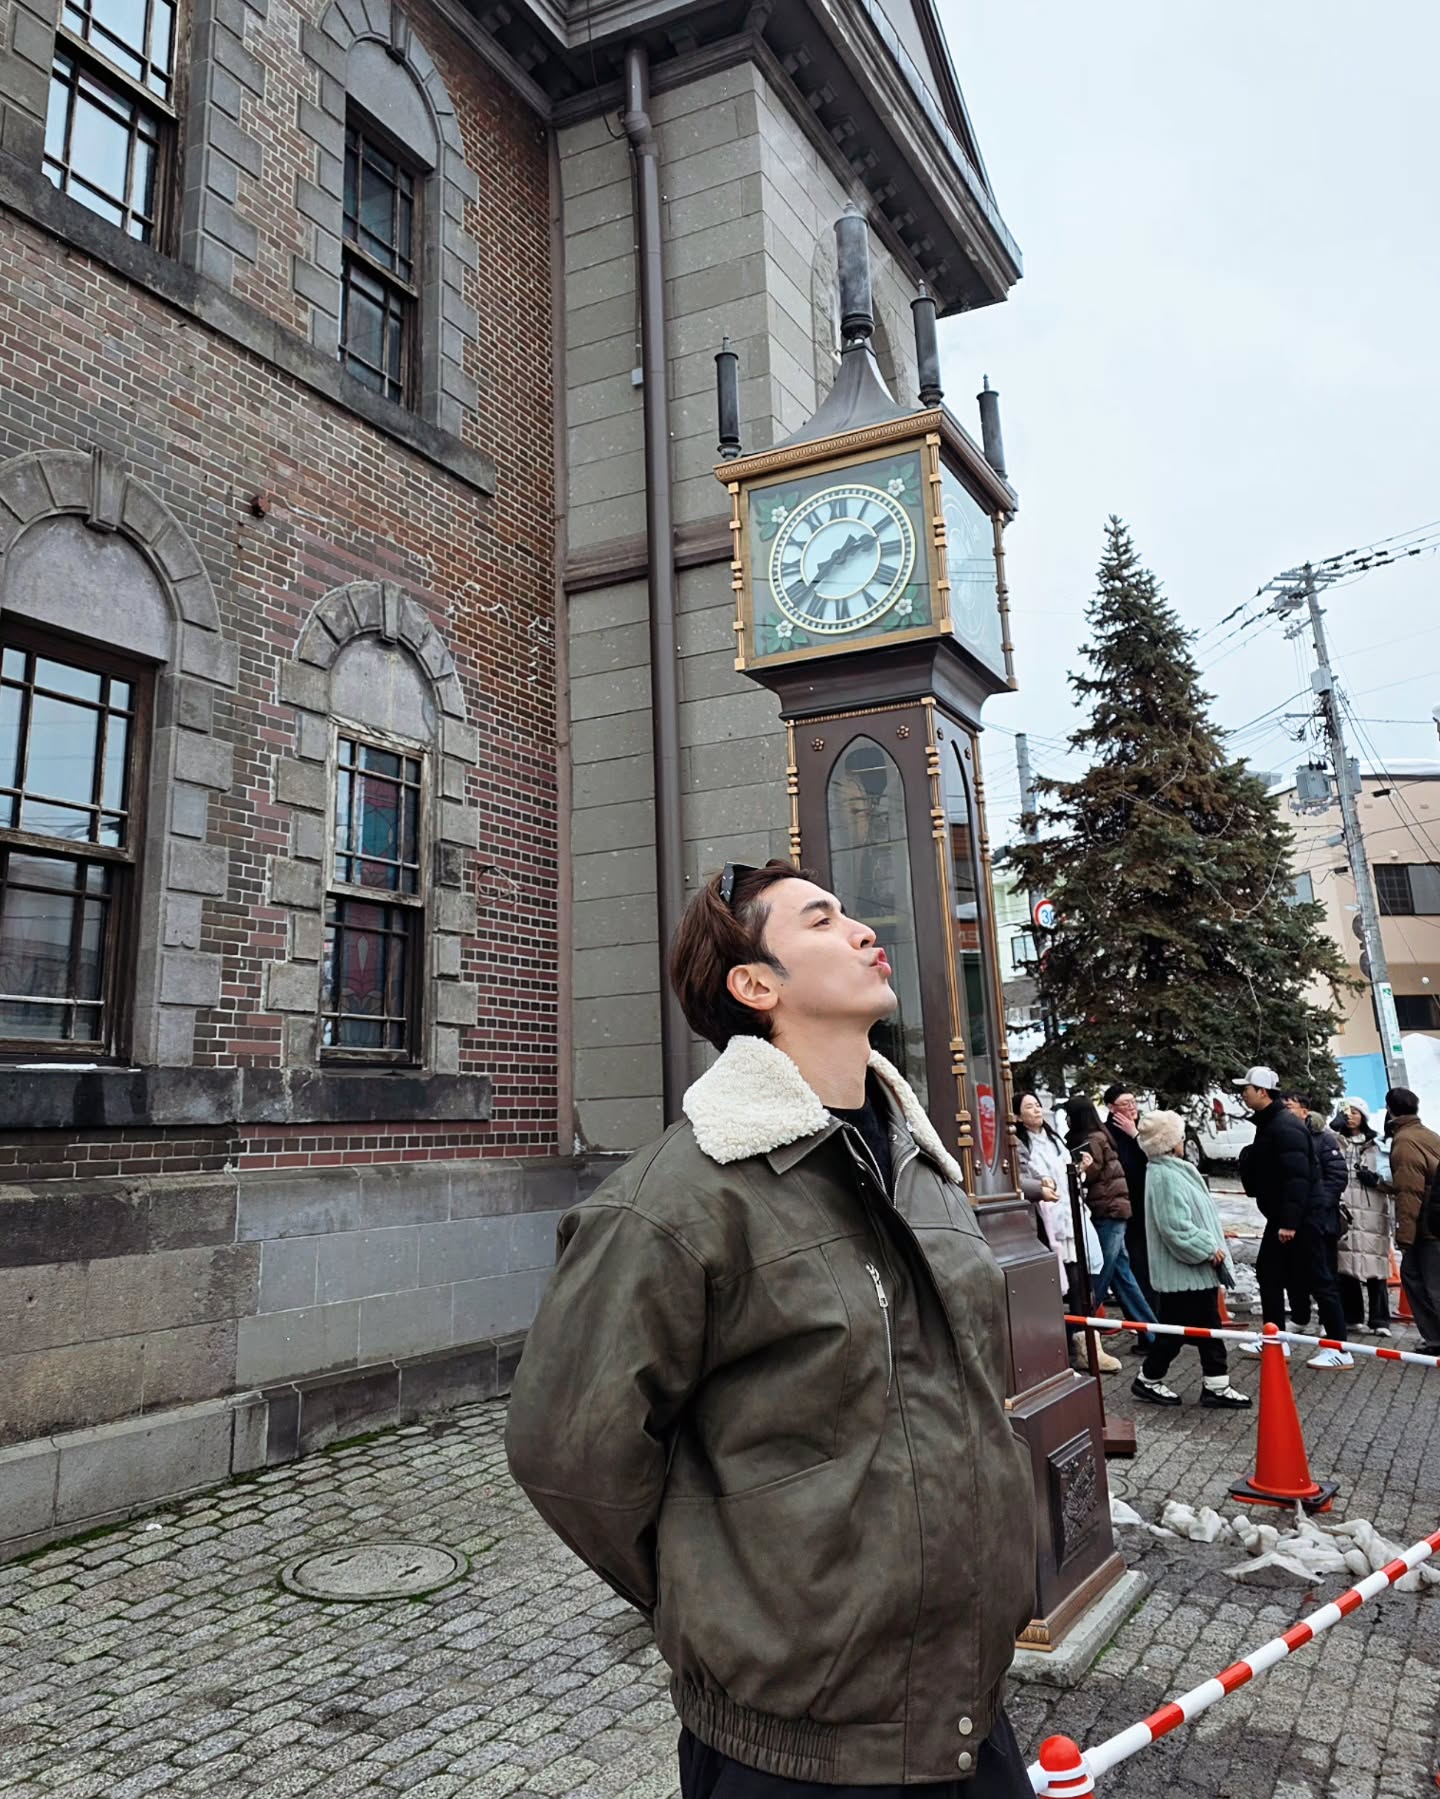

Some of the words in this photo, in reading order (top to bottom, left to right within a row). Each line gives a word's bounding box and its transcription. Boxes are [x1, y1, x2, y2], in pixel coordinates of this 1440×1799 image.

[828, 499, 848, 520] XII
[857, 500, 870, 520] I
[803, 510, 824, 534] XI
[871, 514, 896, 534] II
[785, 536, 807, 551] X
[880, 539, 903, 557] III
[862, 588, 879, 609] V
[835, 599, 851, 621] VI
[1041, 909, 1057, 926] 30
